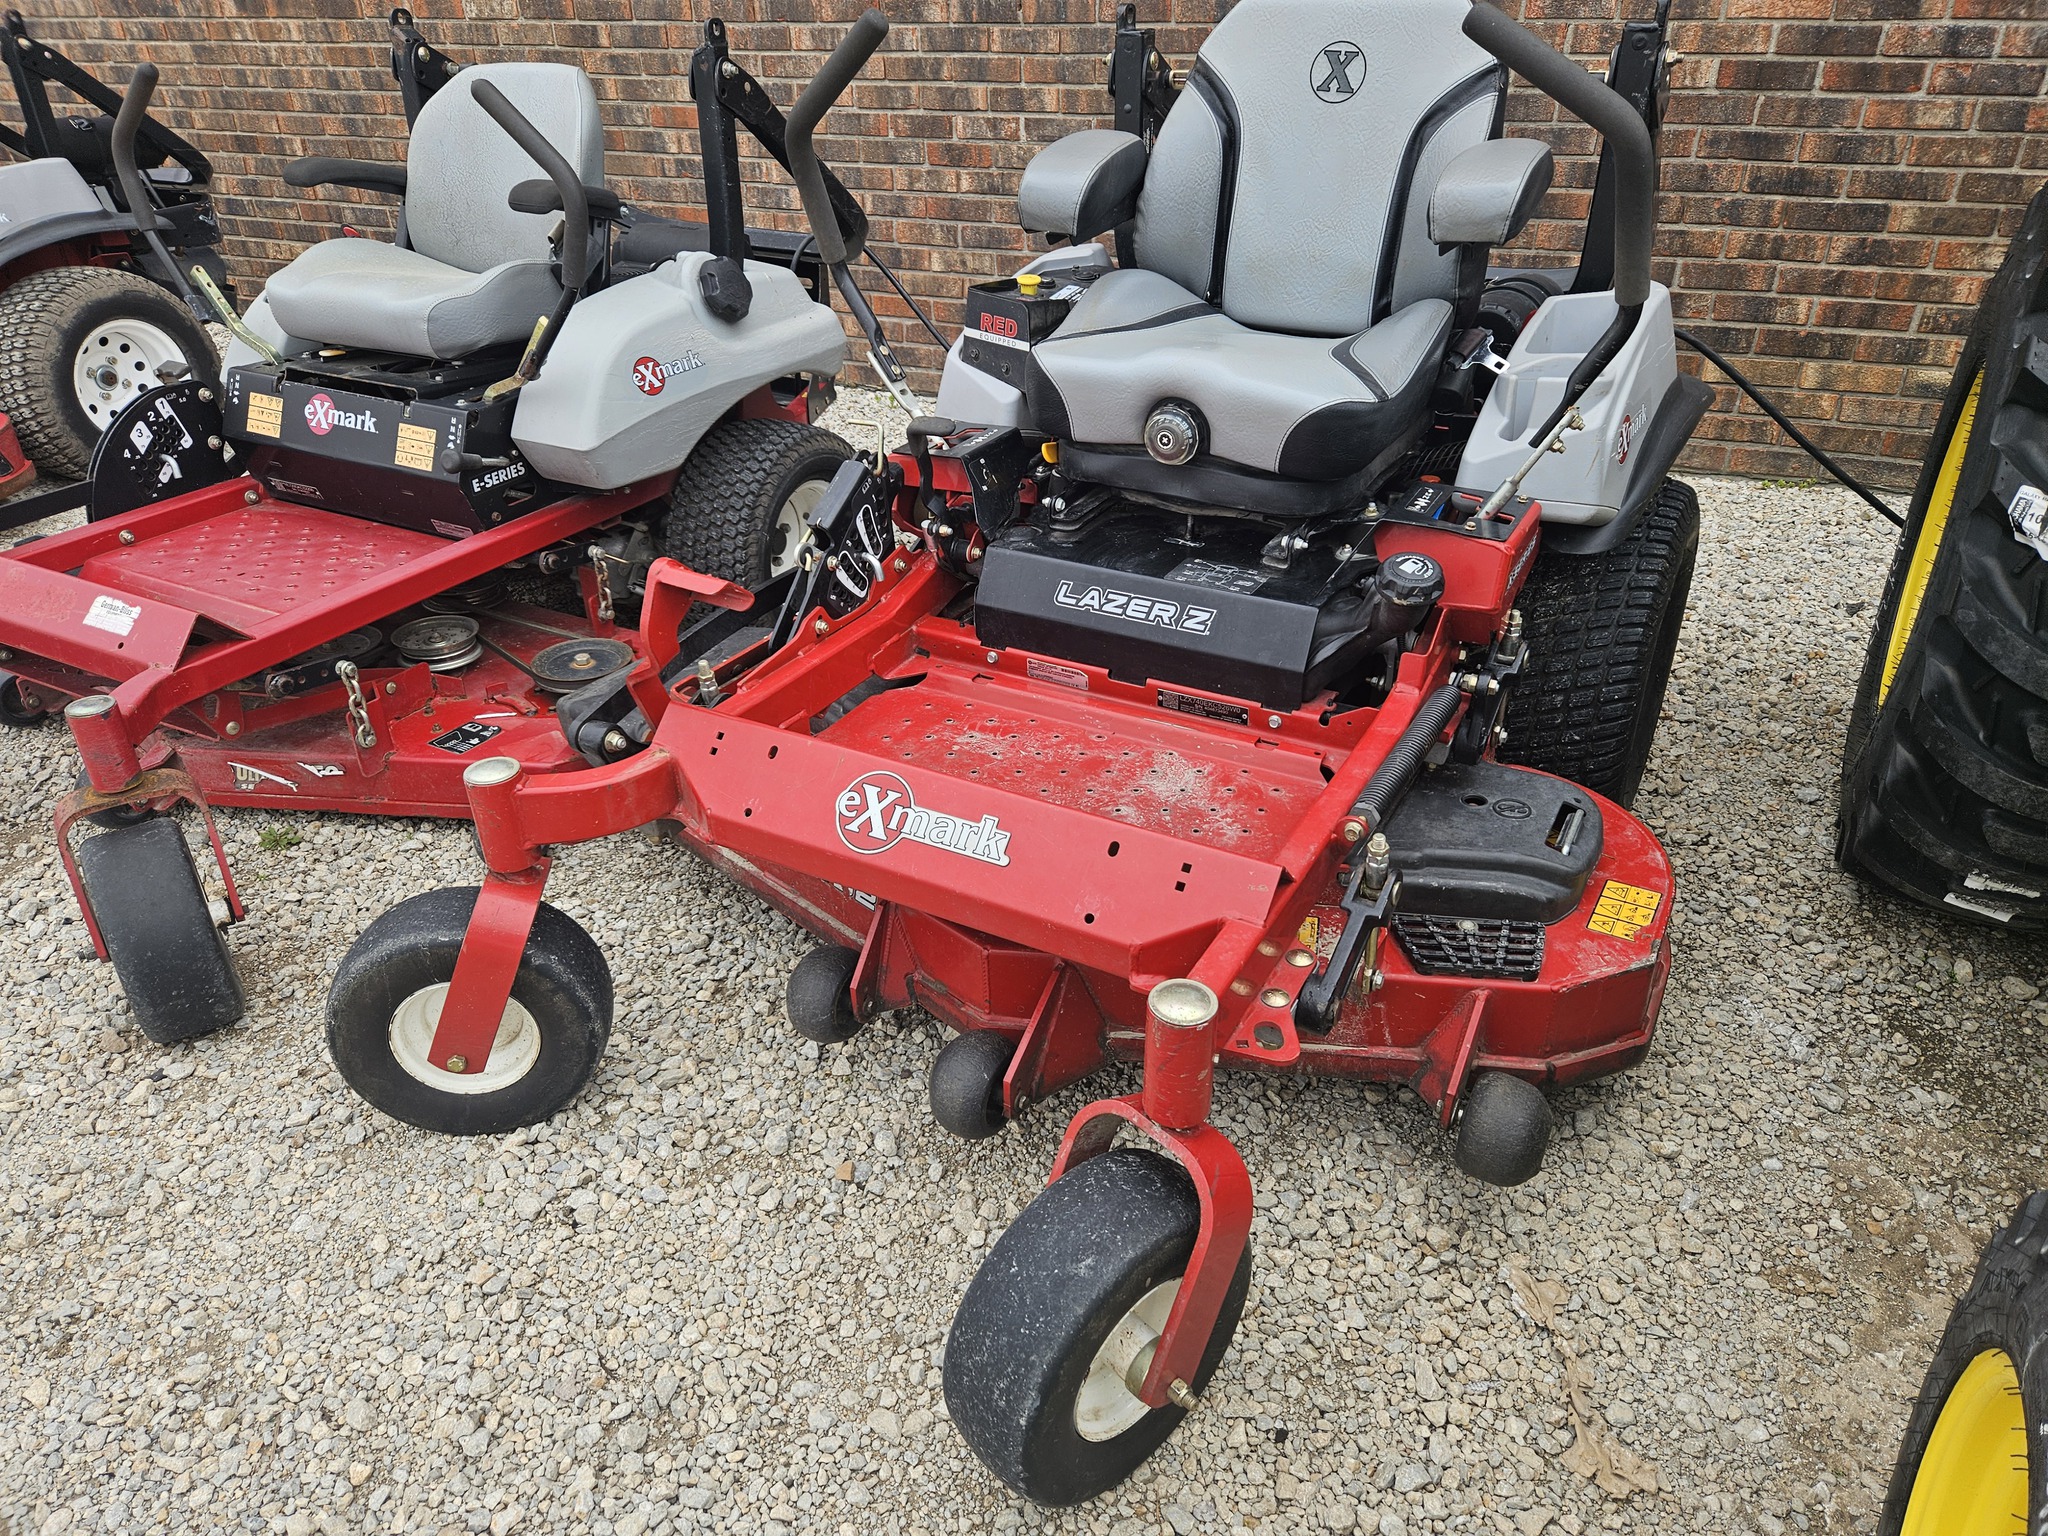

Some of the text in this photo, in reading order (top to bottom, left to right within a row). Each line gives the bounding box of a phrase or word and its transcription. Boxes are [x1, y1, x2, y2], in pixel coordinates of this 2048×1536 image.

[1316, 50, 1359, 93] X
[979, 332, 1017, 347] EQUIPPED
[980, 312, 1018, 337] RED
[632, 349, 703, 391] eXmark
[304, 399, 379, 434] eXmark
[1616, 403, 1648, 459] eXmark
[471, 461, 526, 493] E-SERIES
[1054, 579, 1217, 636] LAZER Z
[838, 782, 1008, 862] eXmark
